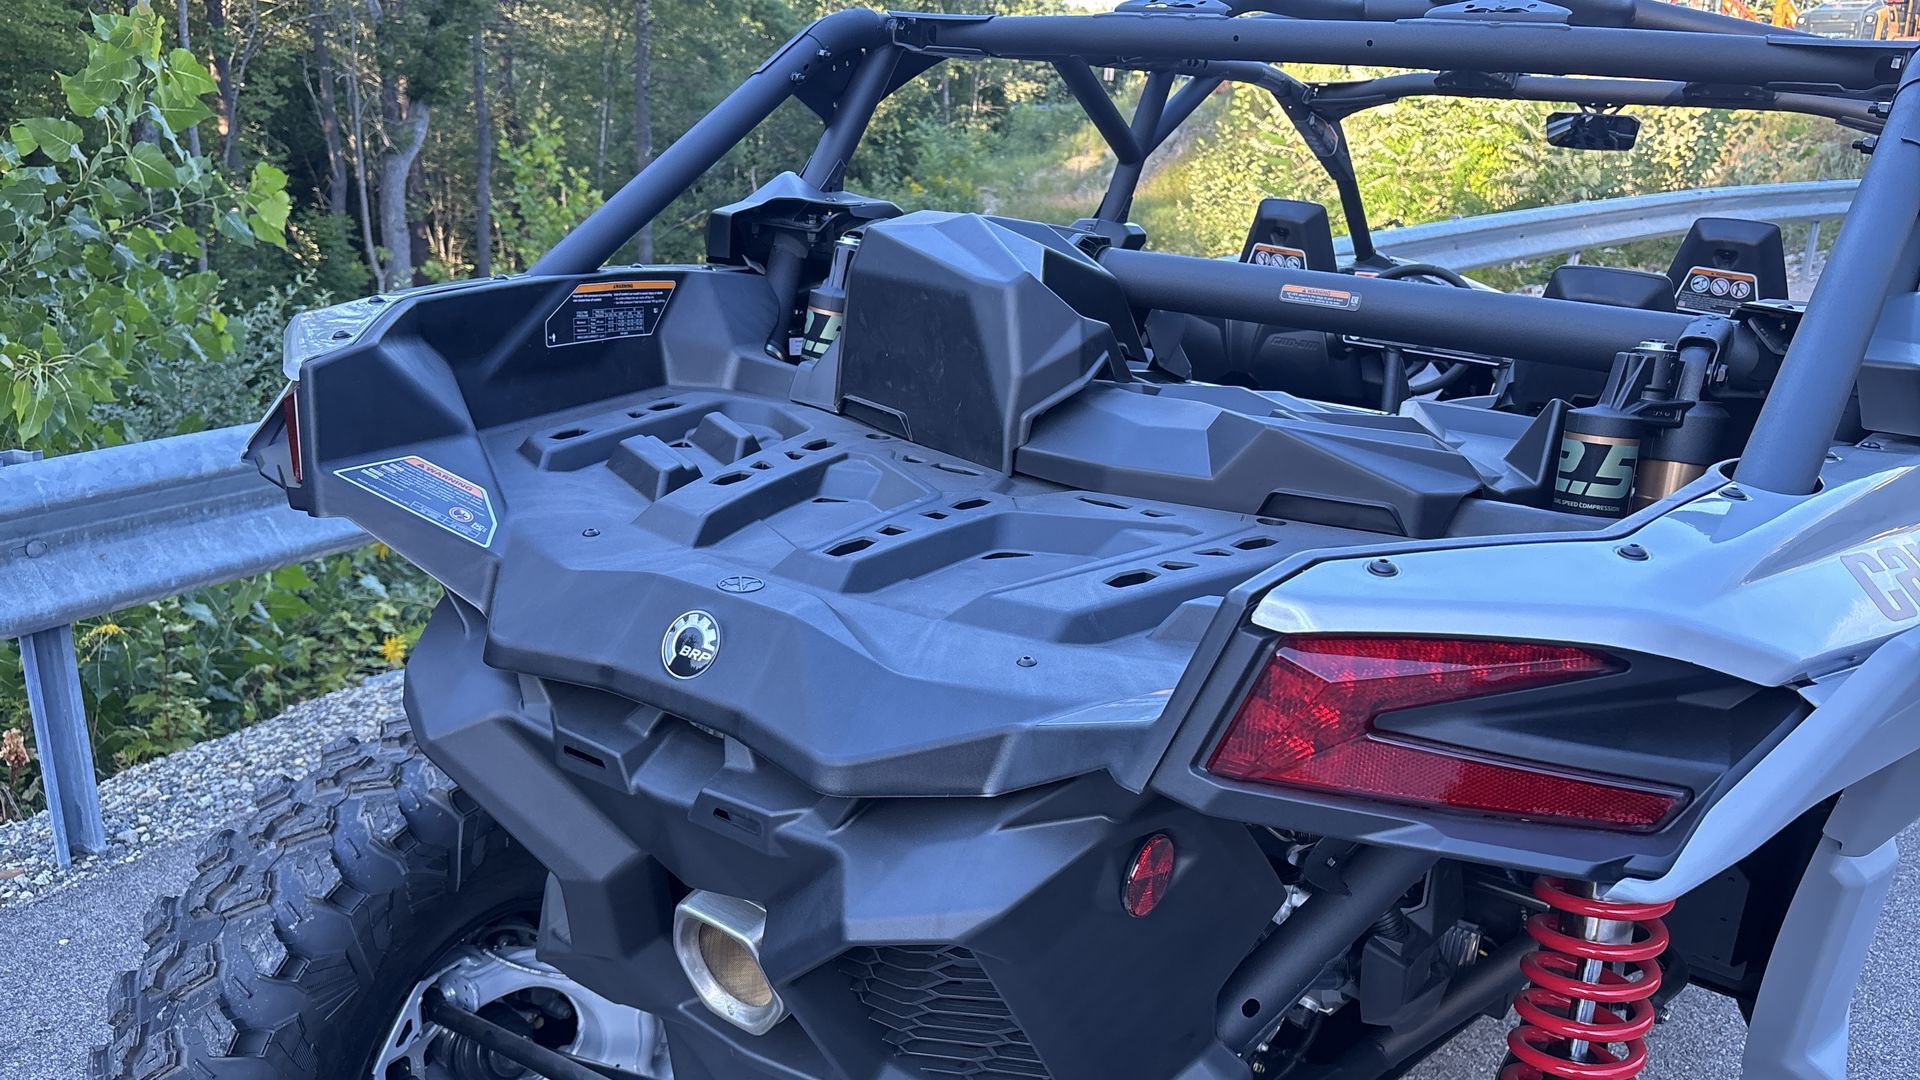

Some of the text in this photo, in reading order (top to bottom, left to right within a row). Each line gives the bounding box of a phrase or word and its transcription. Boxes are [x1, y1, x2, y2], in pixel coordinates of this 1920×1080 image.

[1554, 437, 1640, 499] 2.5
[426, 466, 473, 492] WARNING
[1561, 499, 1579, 508] SPEED
[1578, 501, 1621, 512] COMPRESSION
[679, 645, 713, 661] BRP
